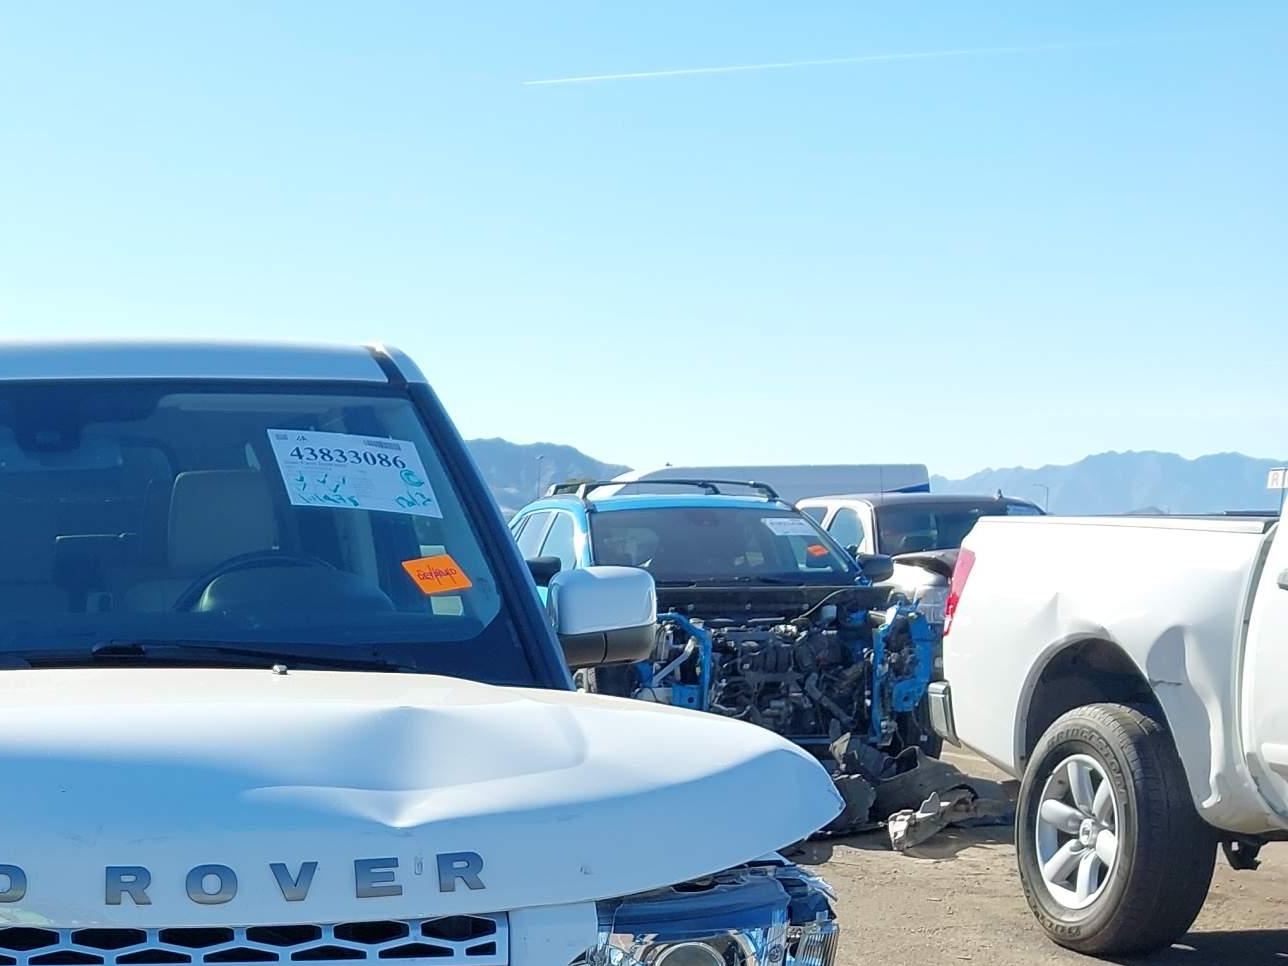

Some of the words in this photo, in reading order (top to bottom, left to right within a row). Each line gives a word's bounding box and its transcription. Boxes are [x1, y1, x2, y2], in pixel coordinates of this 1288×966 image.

[290, 446, 407, 469] 43833086
[1047, 727, 1127, 797] BRIDGESTON
[104, 850, 487, 906] ROVER
